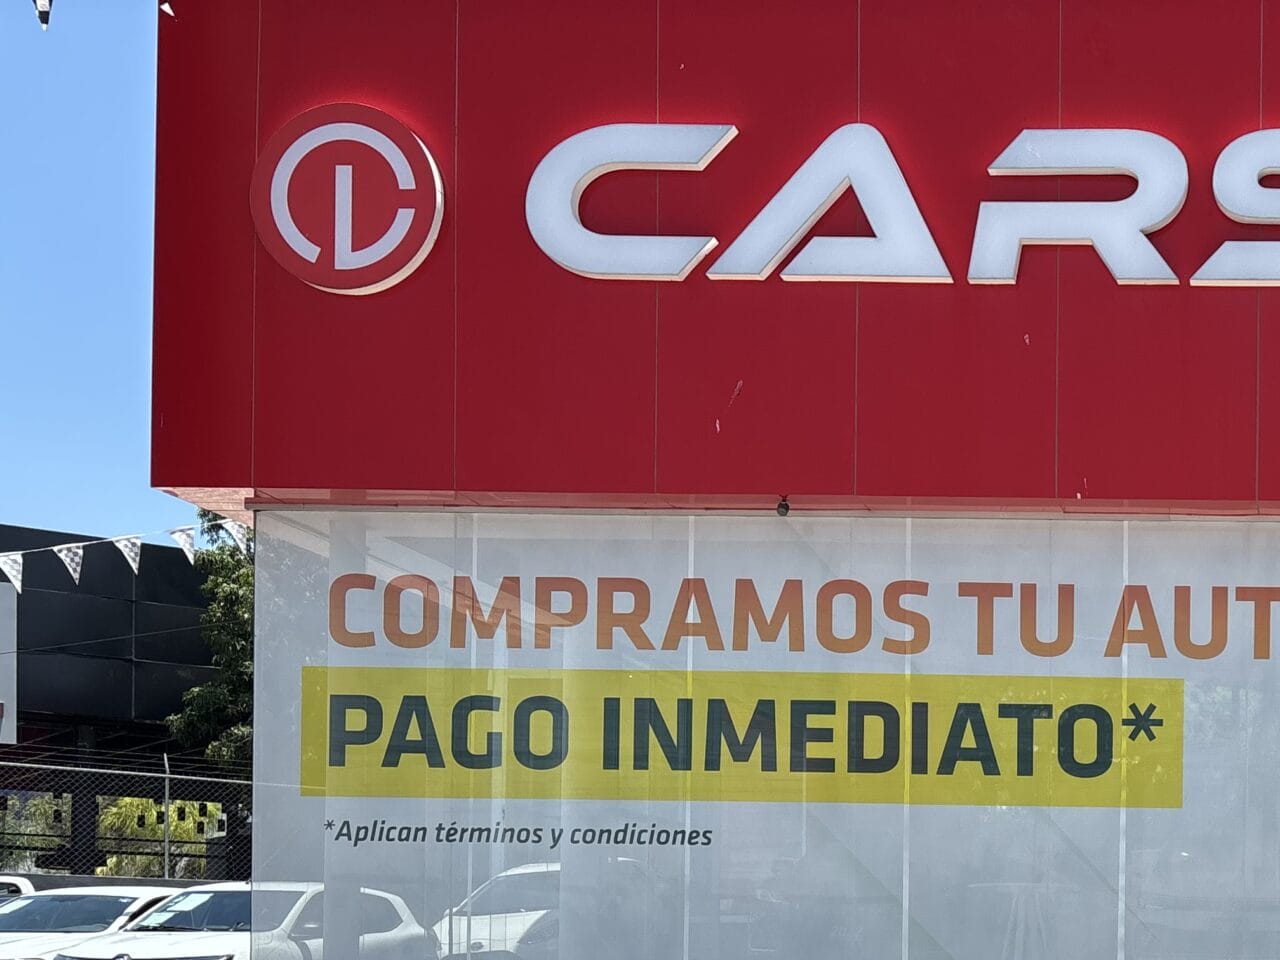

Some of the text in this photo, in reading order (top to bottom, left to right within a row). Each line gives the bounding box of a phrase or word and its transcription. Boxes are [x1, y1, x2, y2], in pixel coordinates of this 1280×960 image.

[328, 573, 931, 655] COMPRAMOS
[958, 581, 1075, 657] TU
[328, 693, 569, 770] PAGO
[434, 820, 543, 845] términos
[549, 828, 564, 849] y
[569, 823, 713, 847] condiciones
